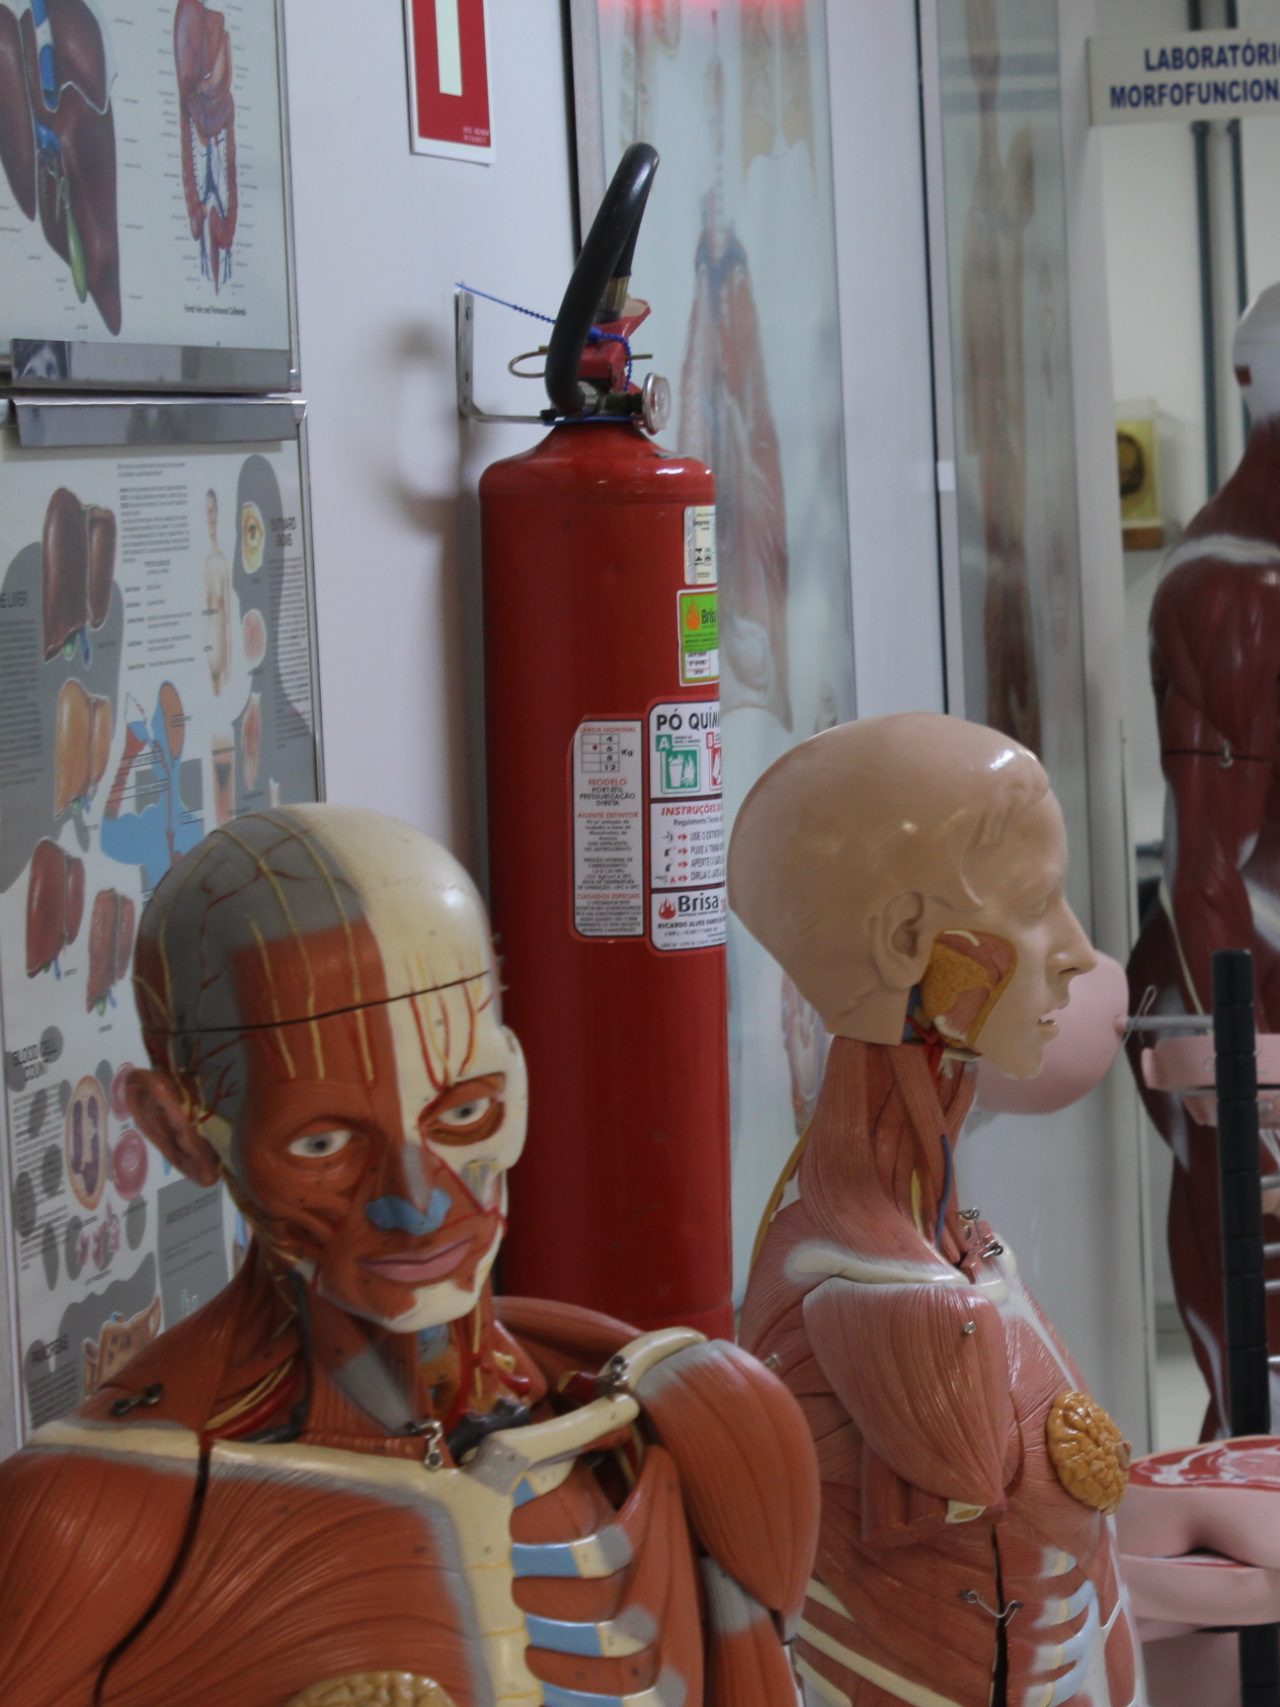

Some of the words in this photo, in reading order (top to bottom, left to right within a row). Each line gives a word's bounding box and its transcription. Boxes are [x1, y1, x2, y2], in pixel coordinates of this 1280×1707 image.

[656, 707, 683, 731] PÓ
[588, 778, 627, 786] MODELO
[661, 802, 717, 816] INSTRUÇÕES
[677, 892, 719, 913] Brisa
